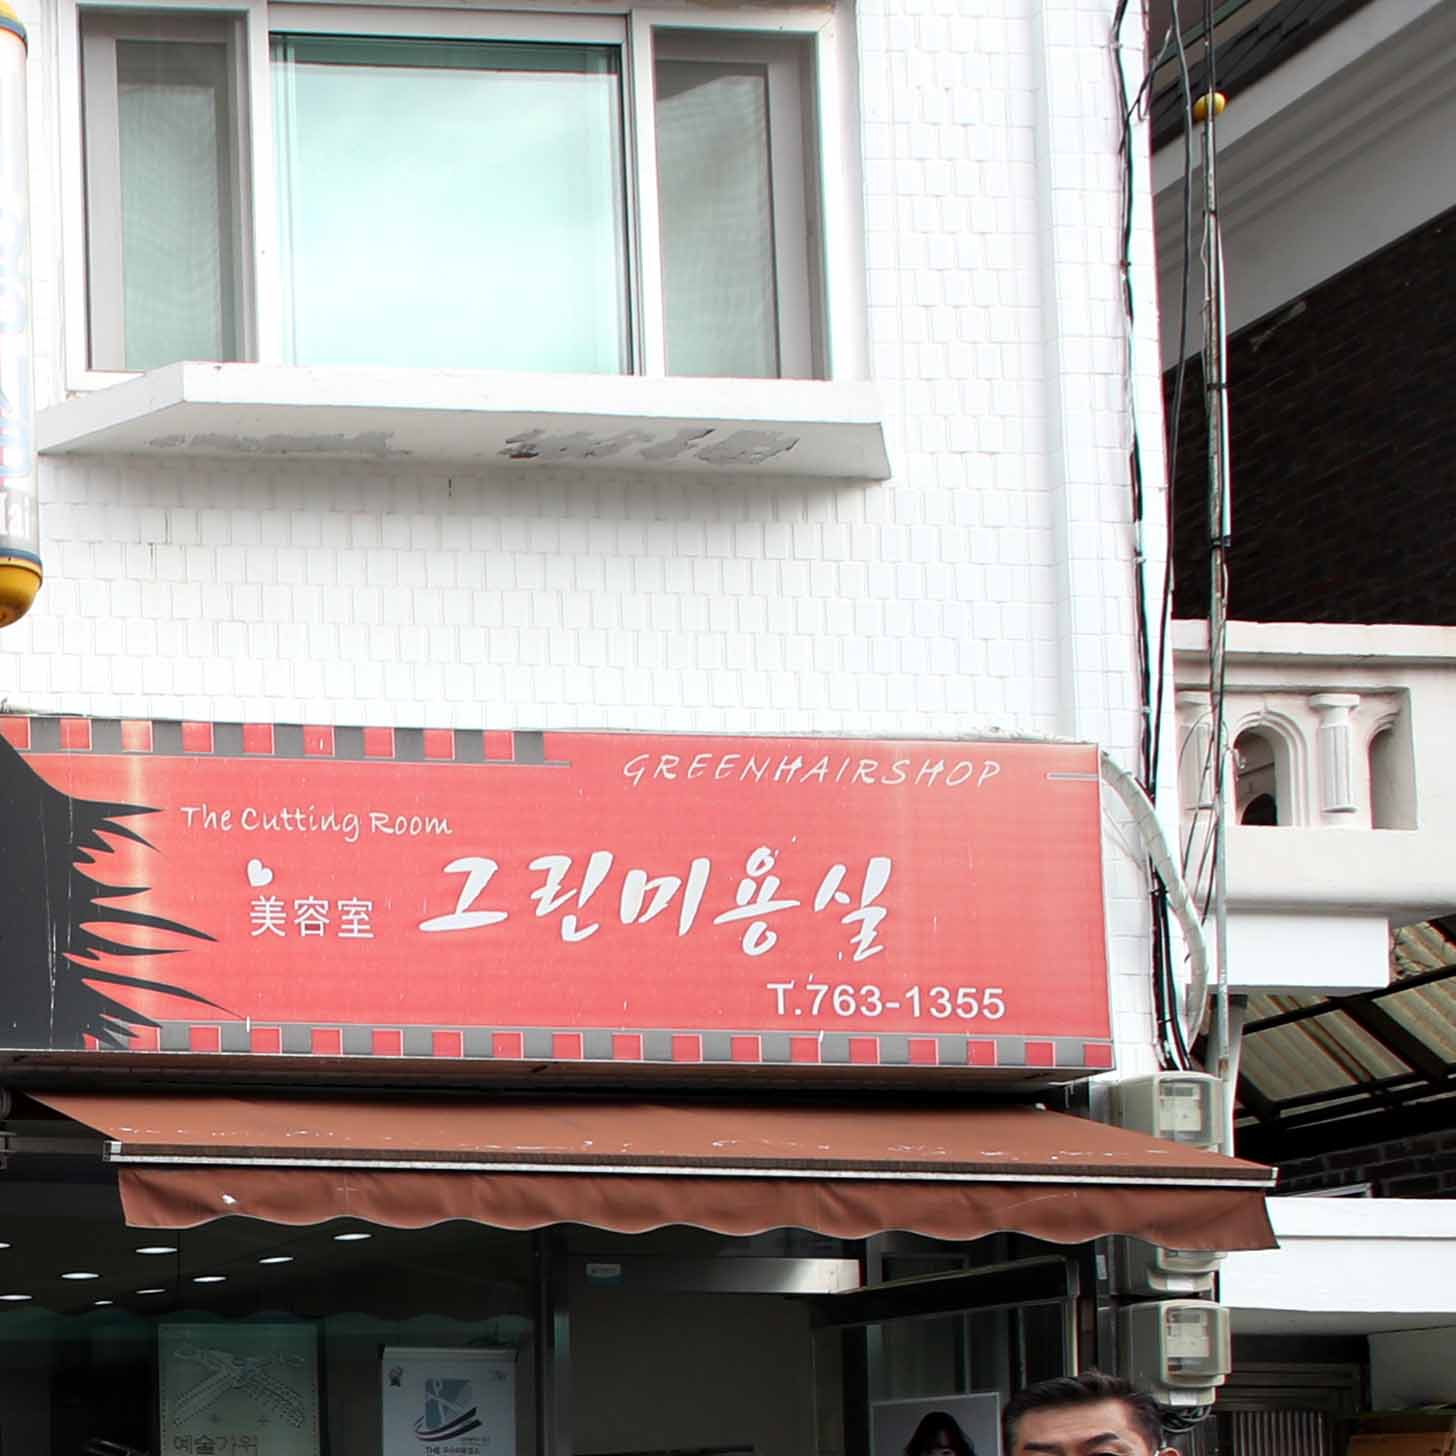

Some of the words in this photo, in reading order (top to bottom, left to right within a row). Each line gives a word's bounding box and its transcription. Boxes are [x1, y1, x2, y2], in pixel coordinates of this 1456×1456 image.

[623, 752, 1002, 788] GREENHAIRSHOP
[180, 804, 233, 832] The
[240, 807, 361, 843] Cutting
[367, 812, 453, 837] Room
[250, 895, 375, 939] 美容室
[418, 846, 892, 962] 그린미용실
[767, 982, 1006, 1020] T.763-1355
